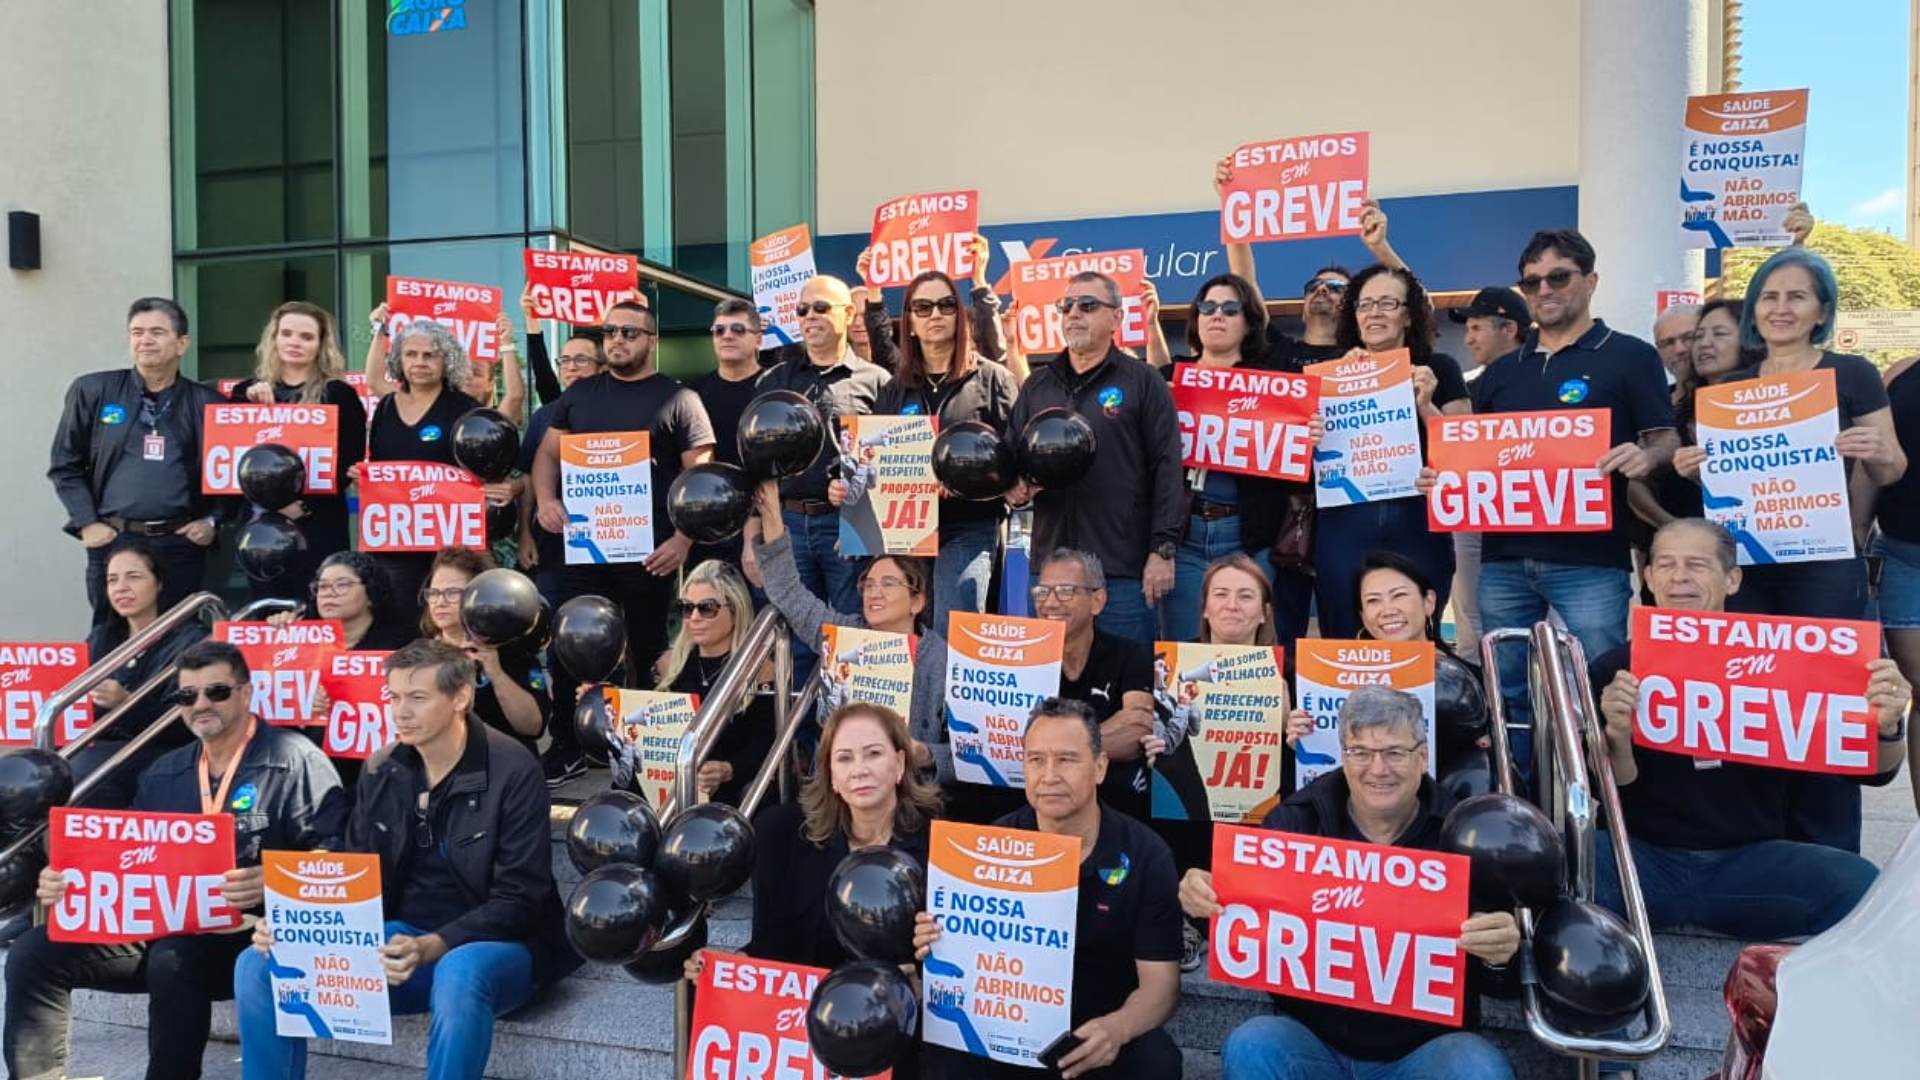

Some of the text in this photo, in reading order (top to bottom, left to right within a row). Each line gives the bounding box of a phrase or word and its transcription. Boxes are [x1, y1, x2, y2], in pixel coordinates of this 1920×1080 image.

[391, 8, 465, 35] CAIXA
[1723, 98, 1770, 112] SAÚDE
[1721, 119, 1769, 131] CAIXA
[1234, 137, 1356, 168] ESTAMOS
[1690, 141, 1763, 156] É NOSSA
[1689, 154, 1799, 171] CONQUISTA!
[1281, 161, 1310, 184] EM
[1725, 177, 1762, 192] NÃO
[880, 195, 968, 222] ESTAMOS
[1724, 192, 1796, 207] ABRIMOS
[1225, 180, 1363, 239] GREVE
[1723, 206, 1767, 221] MÃO.
[908, 216, 929, 235] EM
[532, 254, 628, 272] ESTAMOS
[870, 232, 973, 283] GREVE
[1022, 256, 1132, 282] ESTAMOS
[571, 273, 594, 286] EM
[396, 281, 493, 303] ESTAMOS
[433, 302, 456, 315] EM
[1019, 296, 1144, 350] GRE
[1336, 359, 1377, 377] SAÚDE
[1181, 368, 1308, 398] ESTAMOS
[1337, 378, 1379, 394] CAIXA
[1734, 384, 1789, 403] SAÚDE
[1227, 397, 1258, 414] EM
[1325, 398, 1378, 417] NOSSA
[216, 407, 326, 424] ESTAMOS
[1325, 407, 1411, 432] ONQUISTA!
[1736, 407, 1791, 425] CAIXA
[256, 426, 283, 444] EM
[1443, 415, 1594, 441] ESTAMOS
[1350, 432, 1383, 448] NÃO
[1705, 433, 1789, 456] É NOSSA
[587, 455, 622, 464] CAIXA
[880, 455, 931, 464] MERECEMO
[1351, 444, 1416, 462] ABRIMOS
[1498, 442, 1535, 466] EM
[1708, 446, 1836, 474] CONQUISTA!
[368, 465, 471, 483] ESTAMOS
[880, 467, 927, 476] RESPEITO.
[1353, 460, 1392, 477] MÃO.
[576, 472, 619, 484] NOSSA
[410, 483, 437, 501] EM
[567, 484, 647, 498] CONQUISTA!
[881, 483, 936, 493] PROPOSTA
[1751, 478, 1796, 497] NÃO
[1432, 468, 1606, 526] GREVE
[1754, 493, 1841, 513] ABRIMOS
[595, 502, 622, 515] NÃO
[882, 494, 929, 529] JÁ!
[363, 503, 481, 547] GREVE
[596, 516, 648, 527] ABRIMOS
[1756, 513, 1809, 532] MÃO.
[597, 528, 630, 540] MÃO.
[228, 625, 335, 644] ESTAMOS
[980, 623, 1026, 638] SAÚDE
[1651, 614, 1858, 655] ESTAMOS
[0, 647, 76, 666] AMOS
[273, 647, 298, 667] EM
[978, 647, 1024, 661] CAIXA
[1217, 650, 1267, 669] NÃO SOMOS
[1338, 646, 1392, 662] SAÚDE
[952, 662, 1017, 688] É NOSSA
[1218, 666, 1276, 682] PALHAÇOS
[1725, 654, 1776, 680] EM
[1, 667, 31, 688] EM
[853, 675, 909, 692] MERECEMOS
[1337, 672, 1392, 685] CAIXA
[251, 670, 328, 720] REV
[951, 686, 1045, 708] CONQUISTA
[1204, 694, 1279, 708] MERECEMOS
[1303, 693, 1312, 710] É
[986, 714, 1018, 731] NÃO
[1204, 709, 1265, 722] RESPEITO.
[1636, 675, 1868, 767] GREVE
[643, 736, 680, 748] MERECE
[988, 732, 1025, 746] ABRI
[1205, 730, 1279, 746] PROPOSTA
[991, 746, 1024, 761] MÃO
[647, 769, 674, 780] PROP
[1206, 746, 1269, 789] JÁ!
[65, 814, 215, 844] ESTAMOS
[976, 836, 1036, 857] SAÚDE
[120, 846, 156, 869] EM
[1233, 834, 1447, 892] ESTAMOS
[299, 859, 344, 875] SAÚDE
[973, 865, 1033, 886] CAIXA
[299, 885, 347, 898] CAIXA
[1312, 886, 1364, 913] EM
[55, 868, 232, 934] GREVE
[934, 886, 1025, 919] É NOSSA
[273, 905, 345, 925] É NOSSA
[275, 929, 379, 946] CONQUISTA!
[314, 953, 350, 971] NÃO
[976, 952, 1023, 976] NÃO
[1215, 903, 1456, 1016] GREVE
[316, 975, 383, 992] ABRIMOS
[974, 976, 1064, 1006] ABRIMOS
[317, 990, 359, 1008] MÃO.
[974, 998, 1029, 1023] MÃO.
